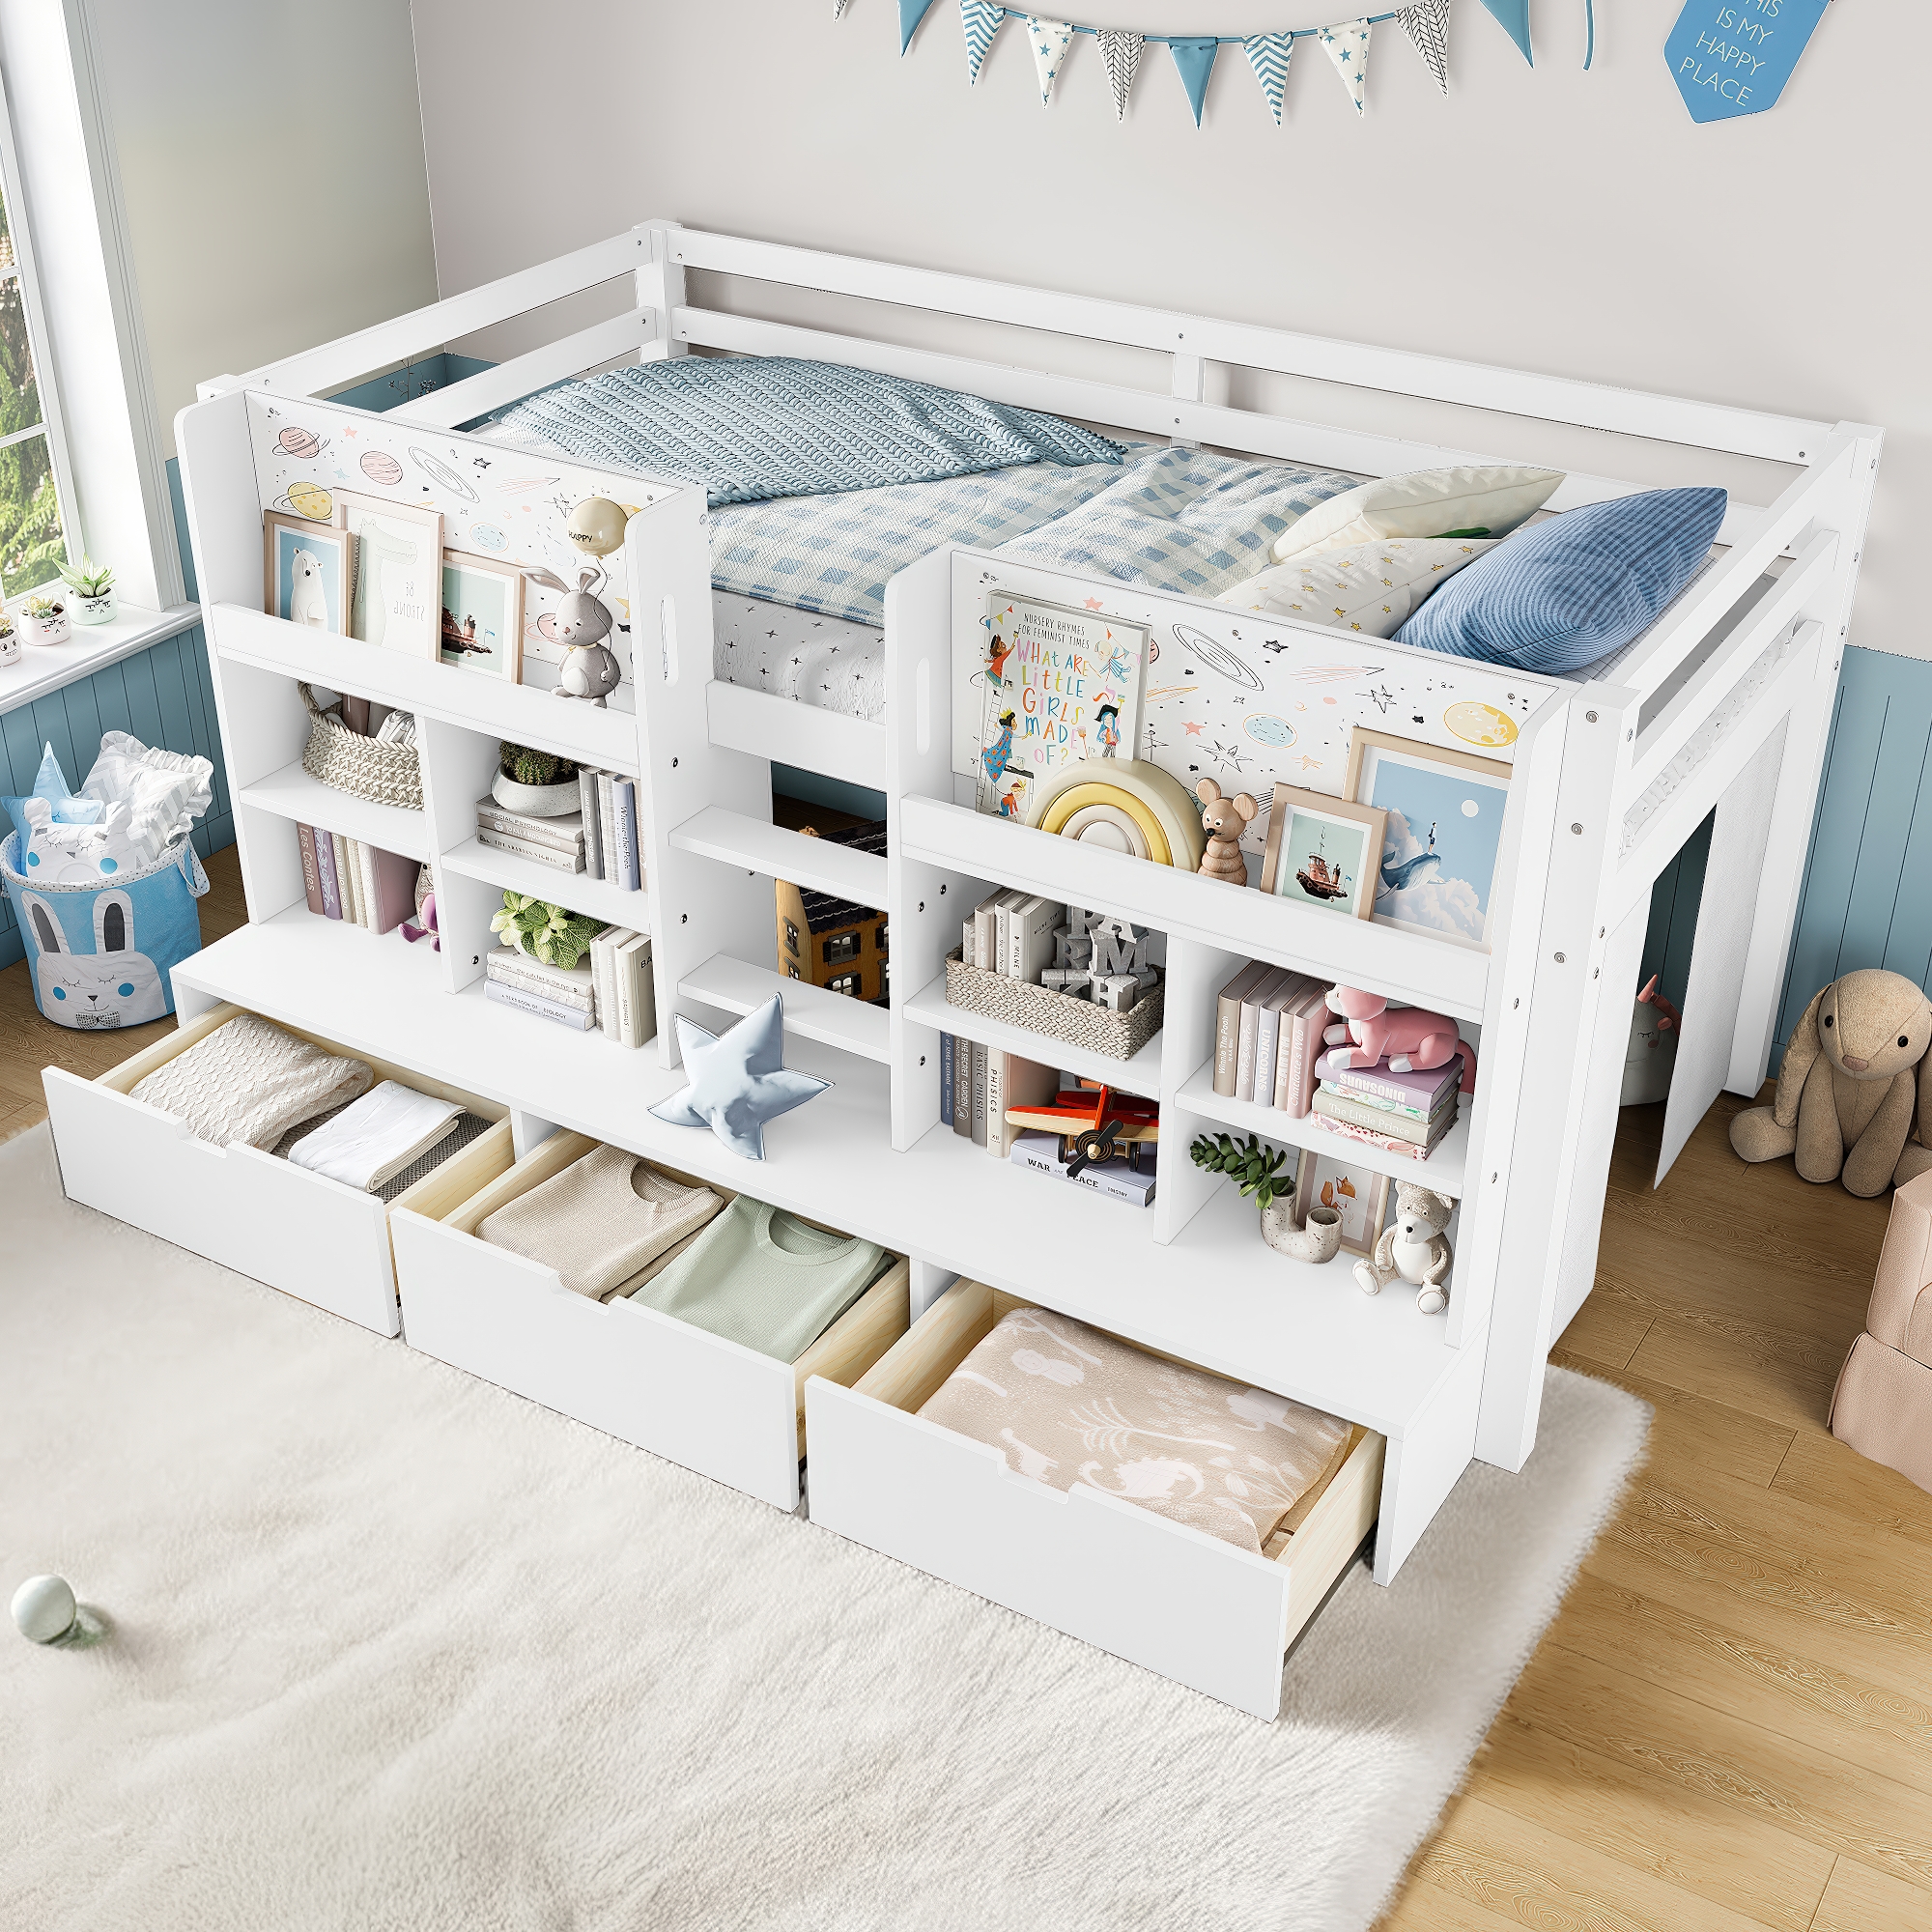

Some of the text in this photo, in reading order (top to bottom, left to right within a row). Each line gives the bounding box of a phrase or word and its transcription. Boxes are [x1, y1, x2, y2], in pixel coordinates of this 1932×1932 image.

[1716, 6, 1774, 45] IS MY
[1695, 30, 1766, 76] HAPPY
[1678, 56, 1753, 106] PLACE
[568, 529, 593, 543] HAPPY
[1018, 624, 1090, 650] FOR FEMINIST TIMES
[1023, 613, 1086, 636] NURSERY RHYMES
[1065, 653, 1091, 677] ARE
[298, 826, 315, 892] Les Contes
[1218, 1050, 1227, 1074] Winnie
[1258, 1029, 1271, 1092] UNICORNS
[1277, 1036, 1290, 1087] EARTH
[1339, 1073, 1406, 1103] DINOSAURS
[1329, 1103, 1410, 1136] The Little Prince
[1027, 1157, 1051, 1172] WAR
[1066, 1174, 1099, 1188] EACE
